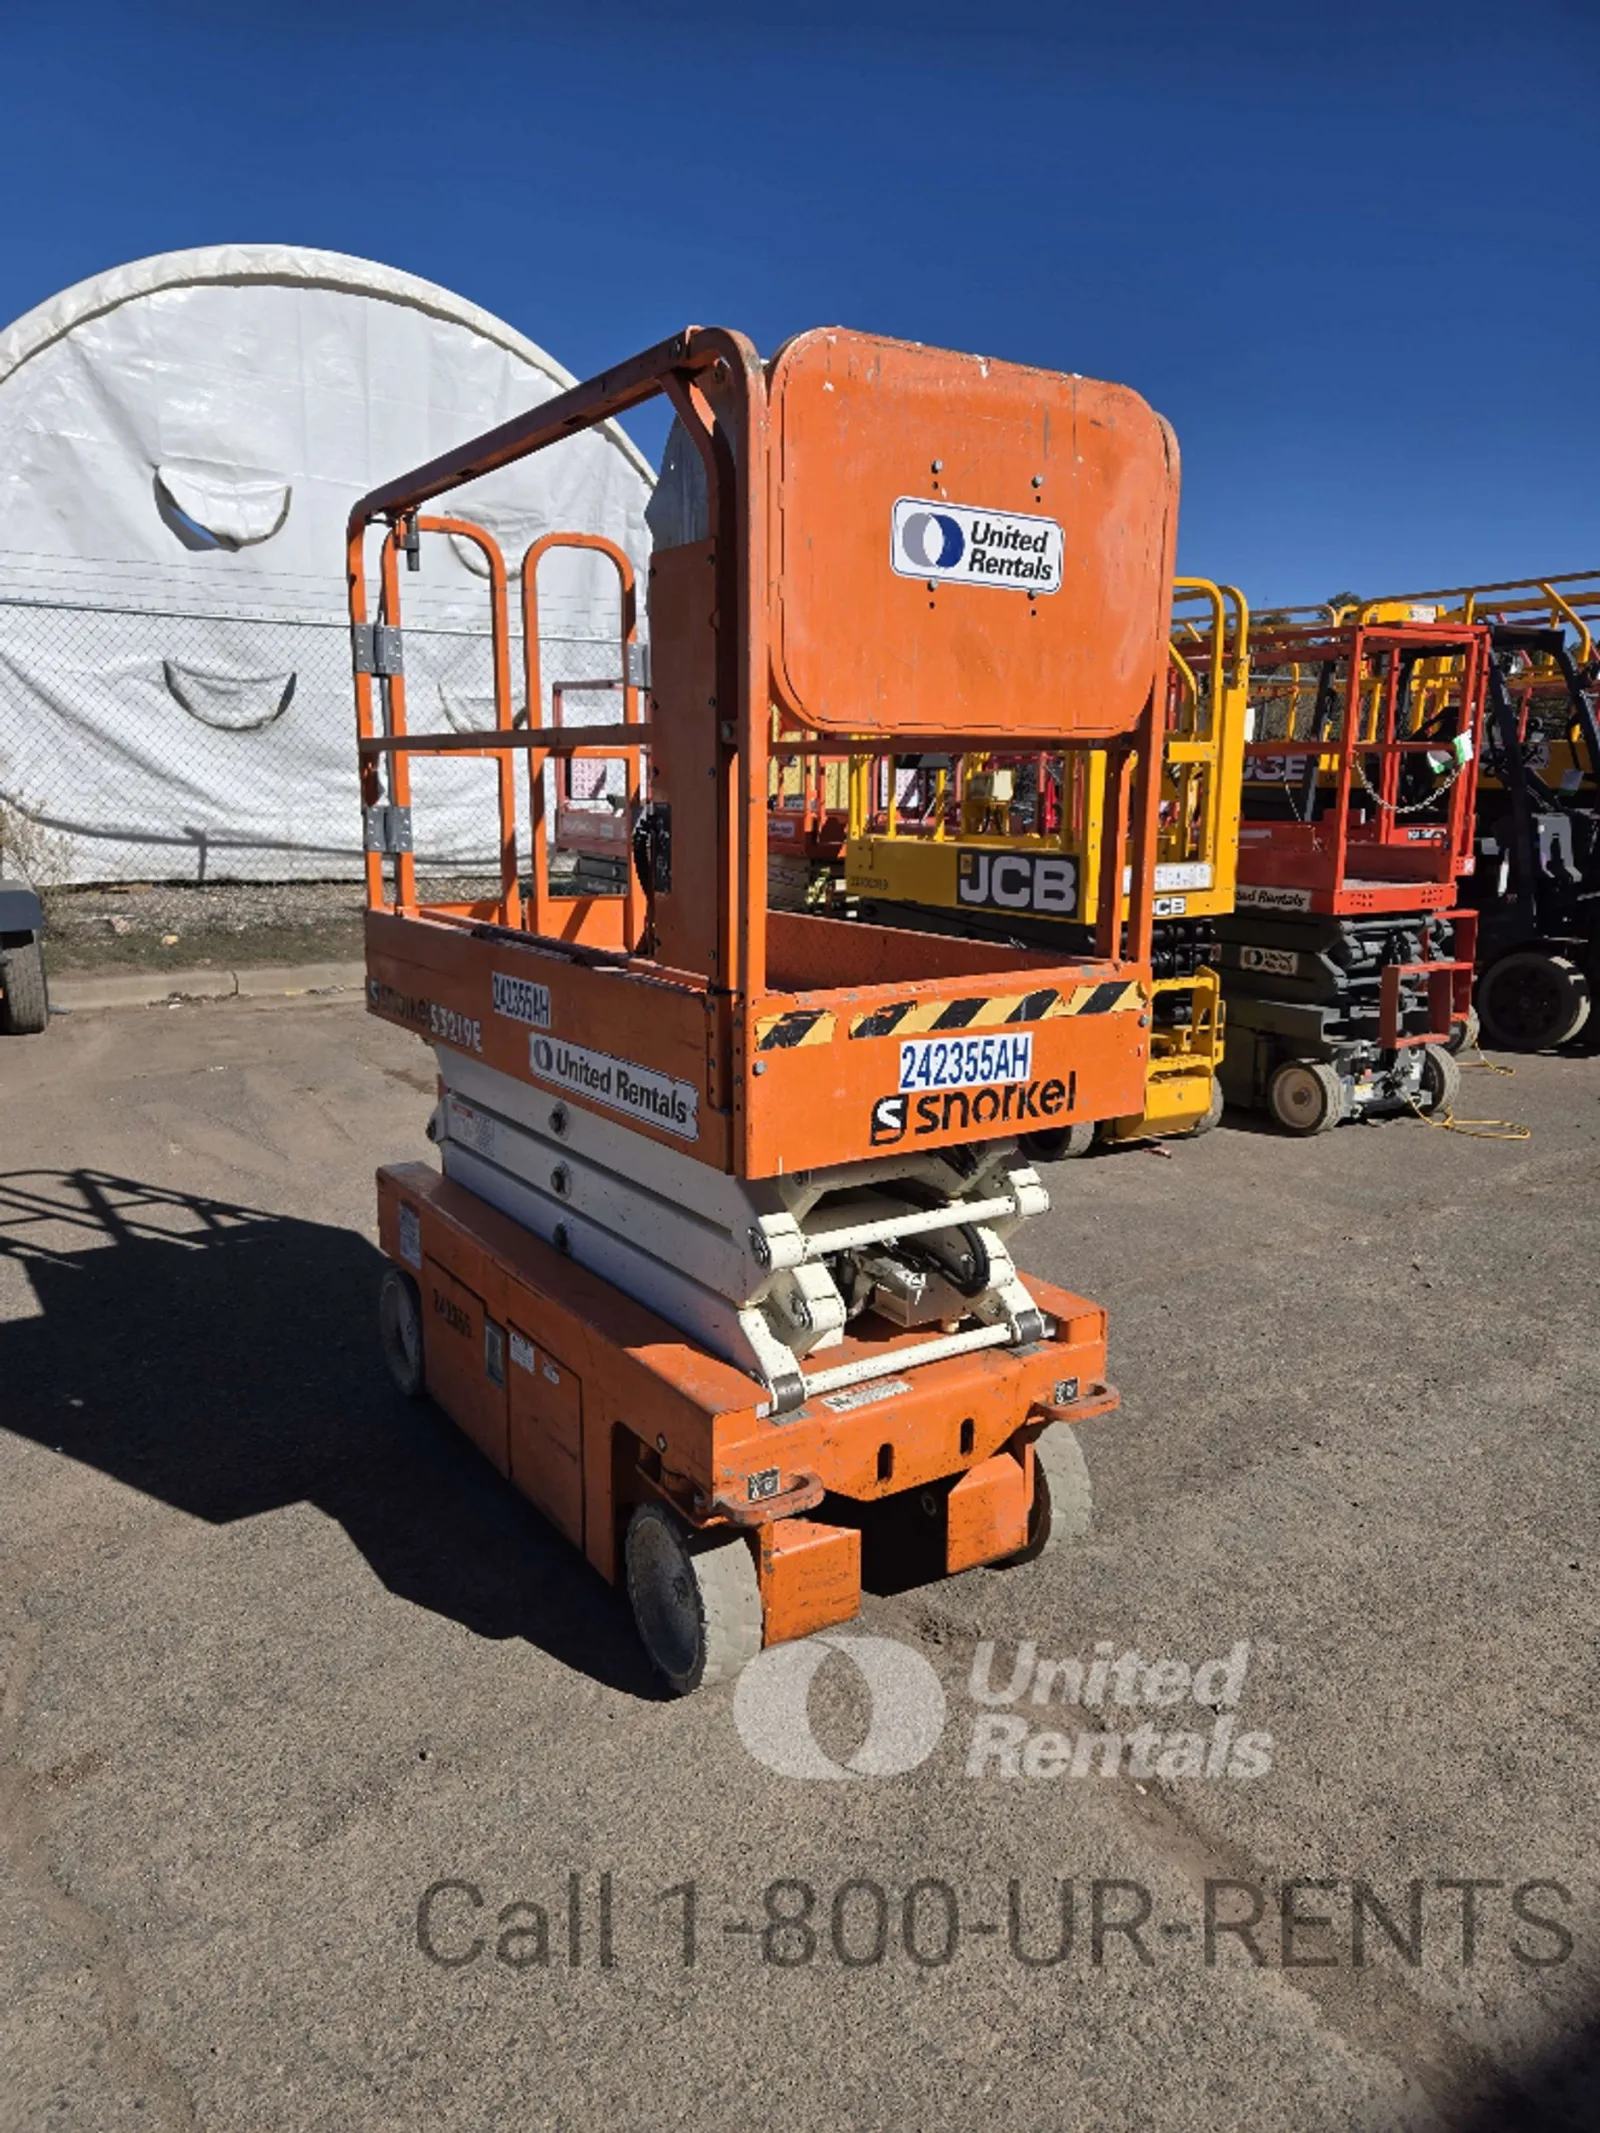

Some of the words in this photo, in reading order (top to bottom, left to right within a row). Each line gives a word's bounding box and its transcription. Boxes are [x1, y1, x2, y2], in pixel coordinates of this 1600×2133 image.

[970, 520, 1049, 553] United
[968, 548, 1053, 581] Rentals
[960, 855, 1076, 911] JCB
[1152, 897, 1185, 916] CB
[493, 974, 549, 1025] 242355AH
[430, 1003, 482, 1053] S3219E
[556, 1048, 611, 1095] United
[616, 1071, 688, 1125] Rentals
[900, 1037, 1030, 1089] 242355AH
[914, 1070, 1077, 1136] snorkel
